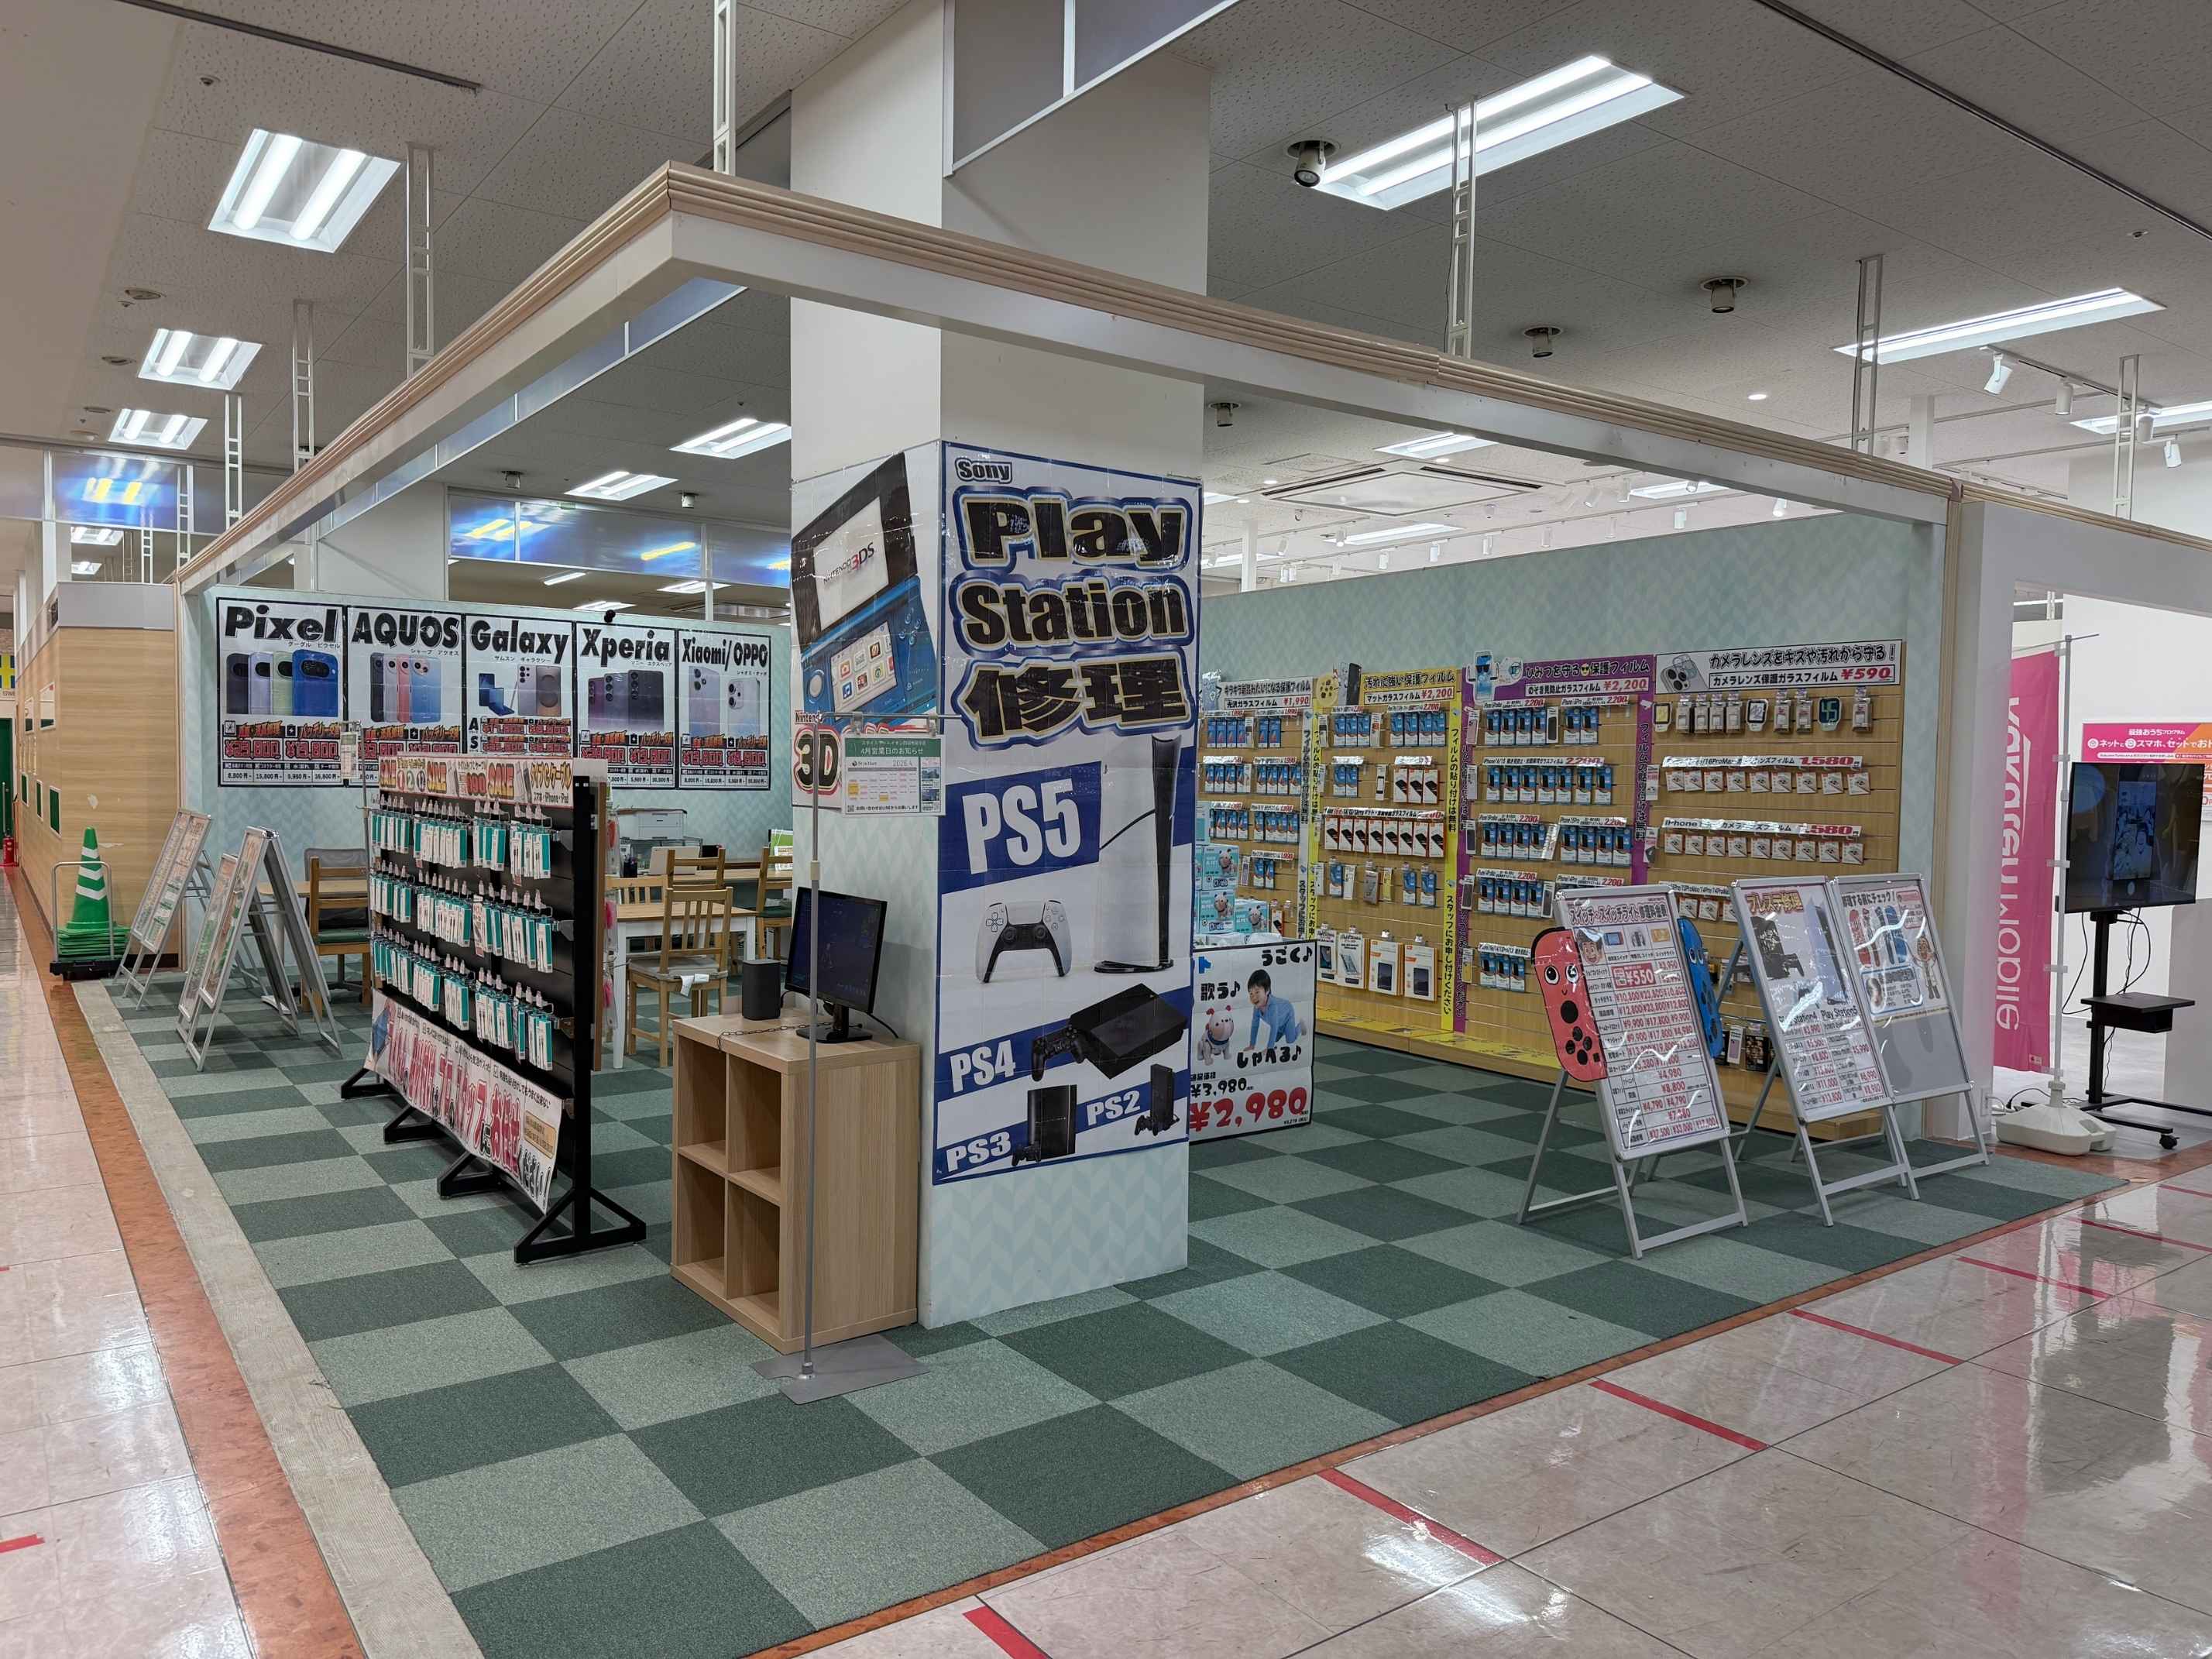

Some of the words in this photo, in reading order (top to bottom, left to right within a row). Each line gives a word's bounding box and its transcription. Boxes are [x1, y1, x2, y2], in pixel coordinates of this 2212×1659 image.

[957, 460, 1011, 482] Sony
[966, 501, 1183, 562] Play
[850, 541, 874, 571] 3DS
[225, 604, 338, 642] Pixel
[960, 582, 1185, 644] Station
[351, 612, 459, 648] AQUOS
[470, 620, 569, 665] Galaxy
[580, 627, 671, 668] Xperia
[1603, 679, 1647, 691] ¥2,200
[1712, 672, 1838, 686] カメラレンズ保護ガラスフィルム
[1840, 667, 1891, 680] ¥590
[964, 658, 1187, 737] 修理
[1226, 699, 1277, 709] 光沢ガラスフィルム
[1283, 696, 1310, 706] ¥1,990
[1367, 693, 1420, 703] マットガラスフィルム
[1421, 688, 1453, 699] ¥2,200
[469, 717, 479, 730] A
[795, 712, 823, 723] Ninten
[469, 735, 479, 749] S
[488, 762, 515, 799] SALE
[1448, 728, 1459, 833] フィルムの貼り付けは無料
[961, 778, 1082, 875] PS5
[1262, 946, 1300, 967] うごく
[1443, 895, 1455, 1015] スタッフにお申し付けください
[1200, 982, 1229, 1001] 歌う
[1626, 968, 1654, 986] ¥550
[949, 1039, 1017, 1093] PS4
[1237, 1046, 1291, 1069] しゃべる
[1190, 1077, 1248, 1098] ¥3,980
[1661, 1080, 1686, 1093] ¥8,800
[1085, 1088, 1142, 1127] PS2
[1189, 1087, 1308, 1133] ¥2,980
[946, 1132, 1012, 1175] PS3
